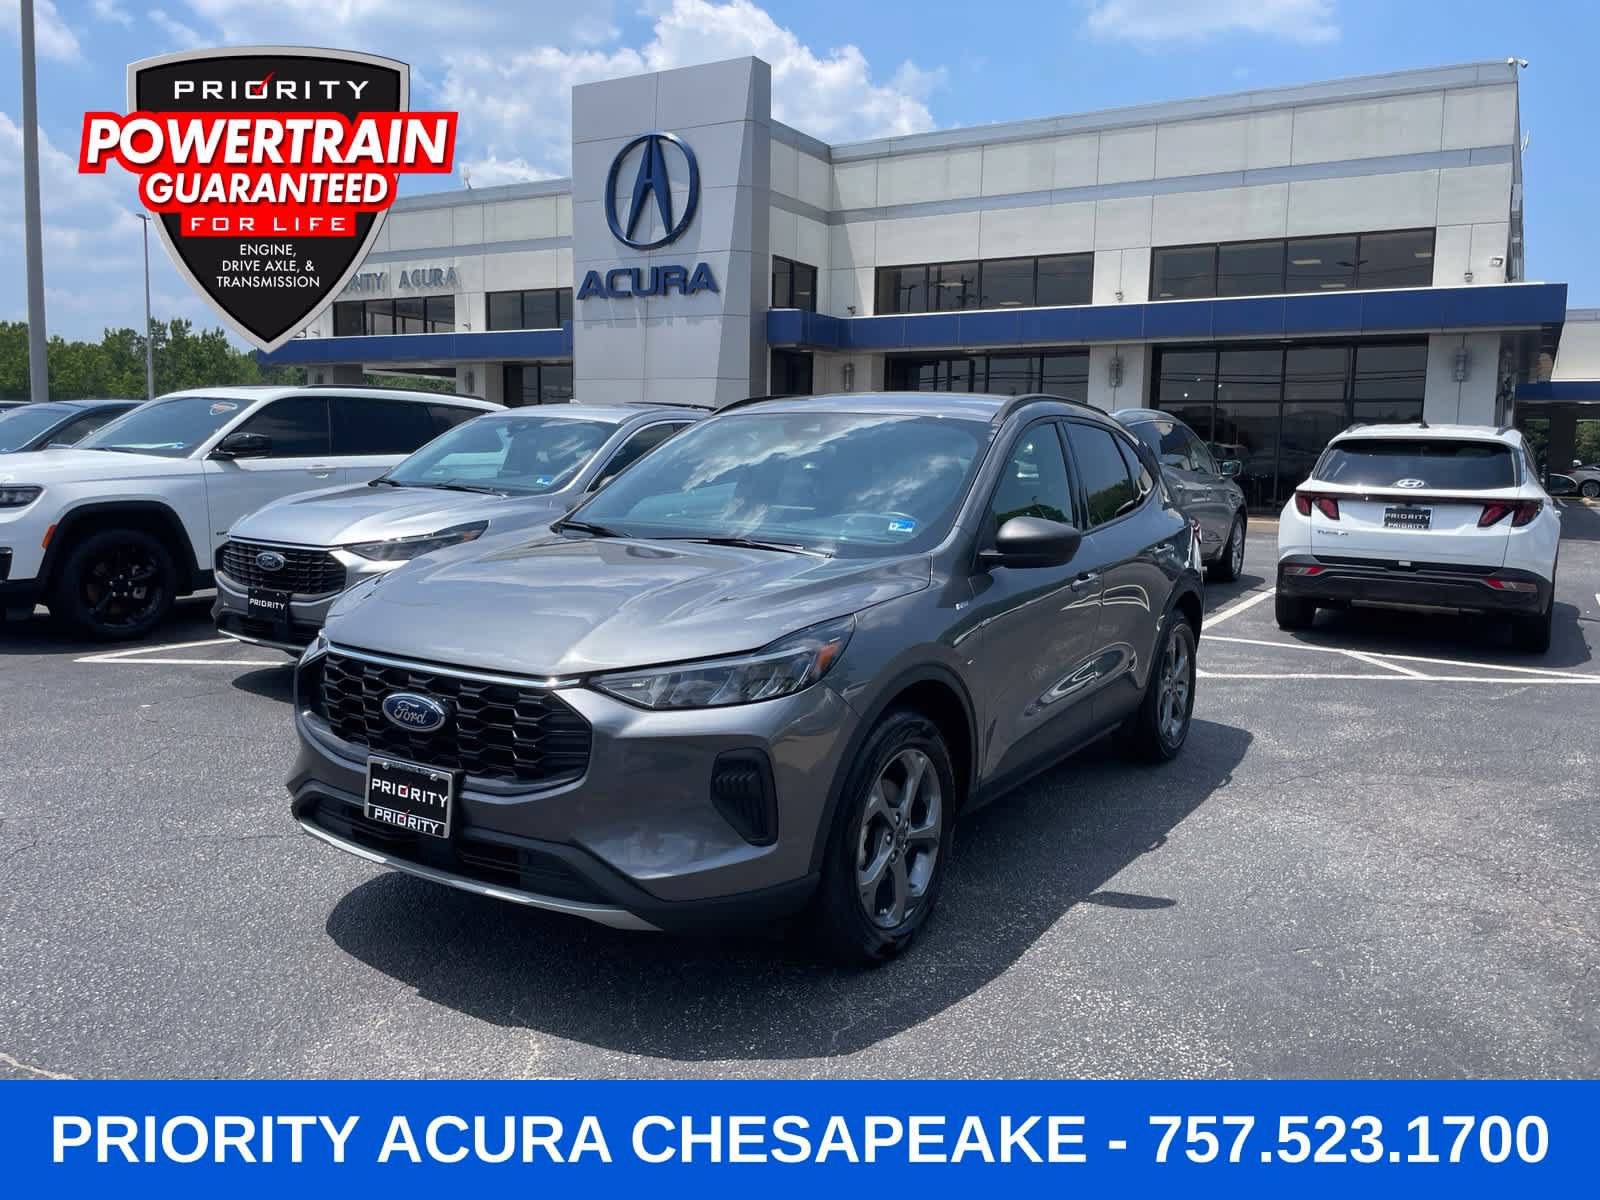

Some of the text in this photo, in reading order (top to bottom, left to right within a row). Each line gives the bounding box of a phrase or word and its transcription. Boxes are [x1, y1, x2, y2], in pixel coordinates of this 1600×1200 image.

[398, 266, 460, 289] ACURA
[576, 262, 720, 300] ACURA
[1385, 512, 1430, 521] PRIORITY
[249, 598, 286, 611] PRIORITY
[393, 700, 428, 725] Ford
[371, 777, 449, 808] PRIORITY
[374, 807, 439, 834] PRIORITY
